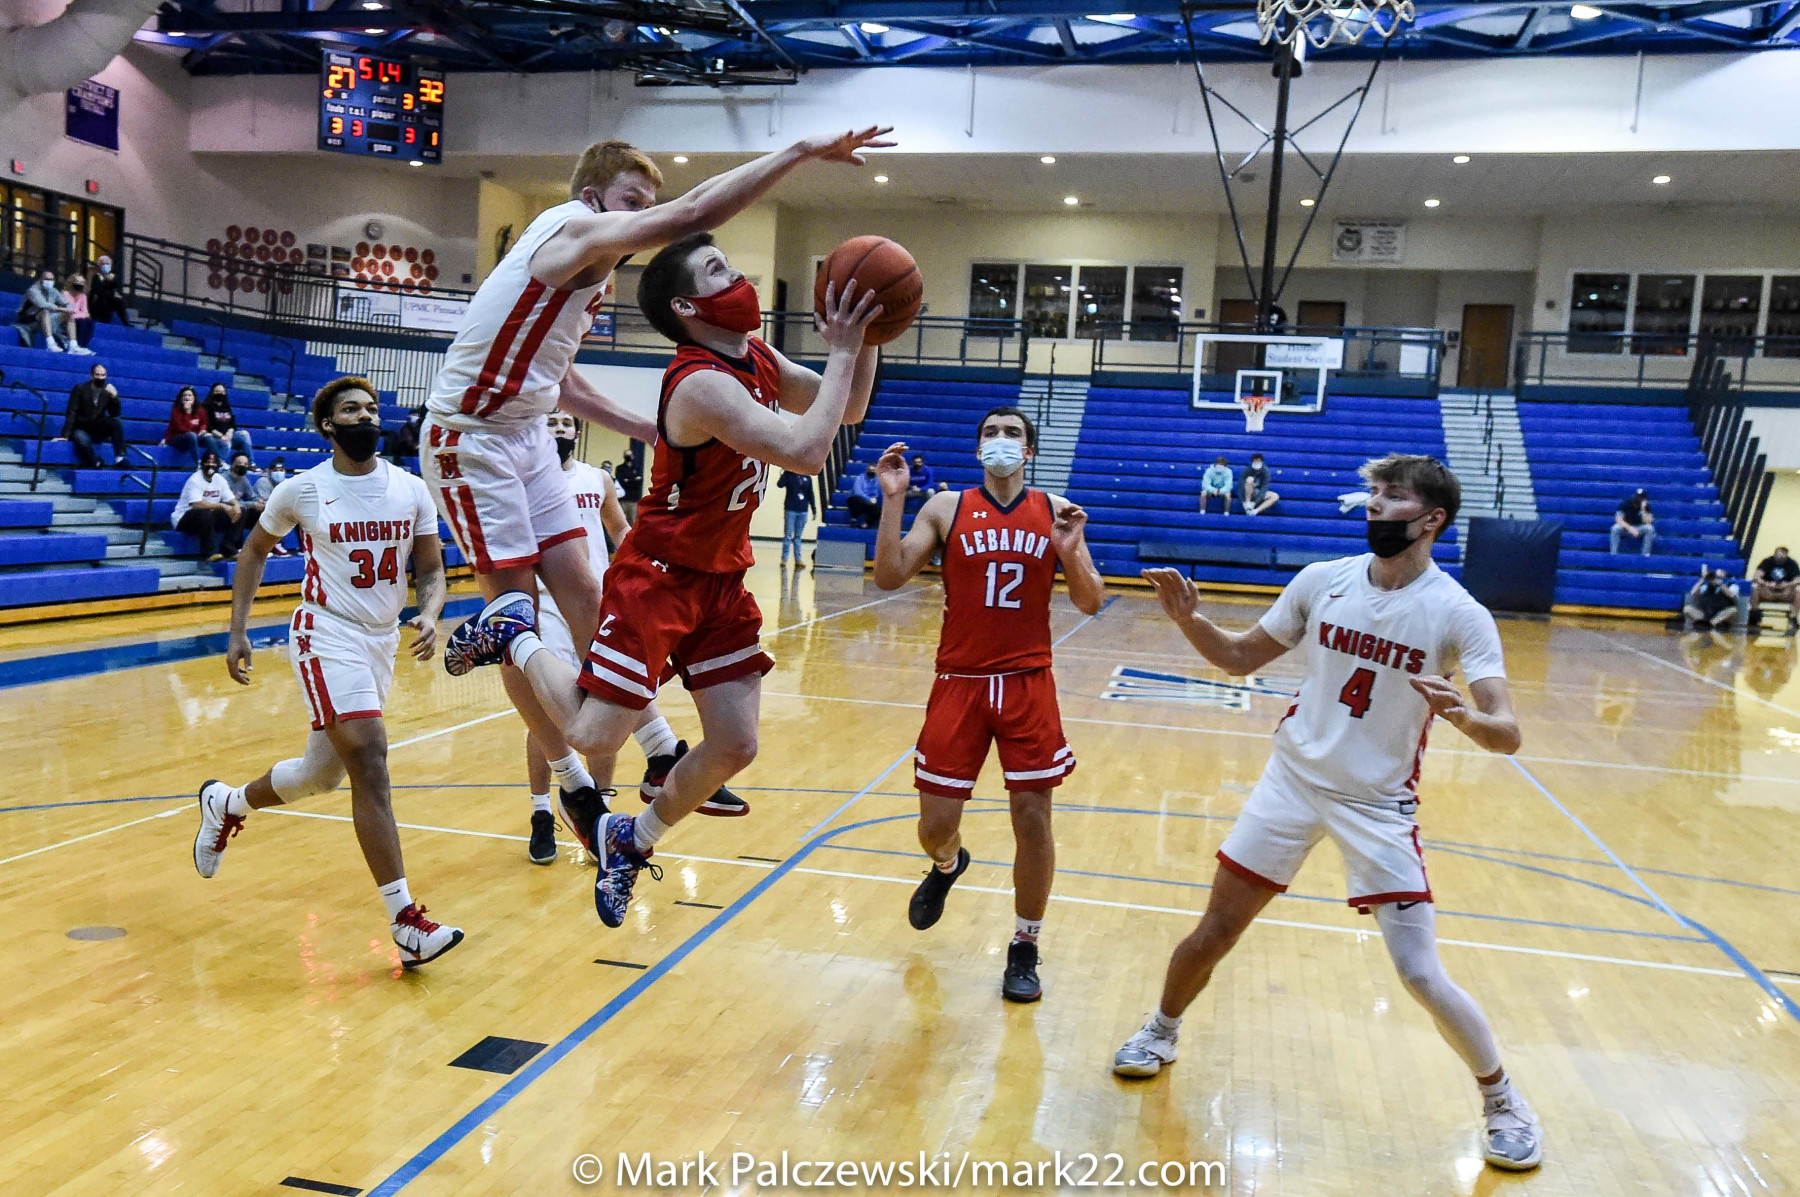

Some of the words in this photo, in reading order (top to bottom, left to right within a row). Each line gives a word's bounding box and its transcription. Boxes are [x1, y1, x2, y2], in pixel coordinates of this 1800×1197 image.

[328, 65, 356, 90] 27
[358, 57, 401, 83] 51.4
[402, 92, 415, 111] 3
[419, 79, 445, 103] 32
[331, 116, 344, 135] 3
[351, 119, 364, 138] 3
[404, 127, 417, 145] 3
[431, 131, 439, 147] 1
[329, 520, 411, 543] KNIGHTS
[959, 528, 1050, 559] LEBANON
[349, 546, 398, 588] 34
[984, 561, 1024, 608] 12
[1319, 621, 1426, 675] KNIGHTS
[1338, 667, 1377, 719] 4
